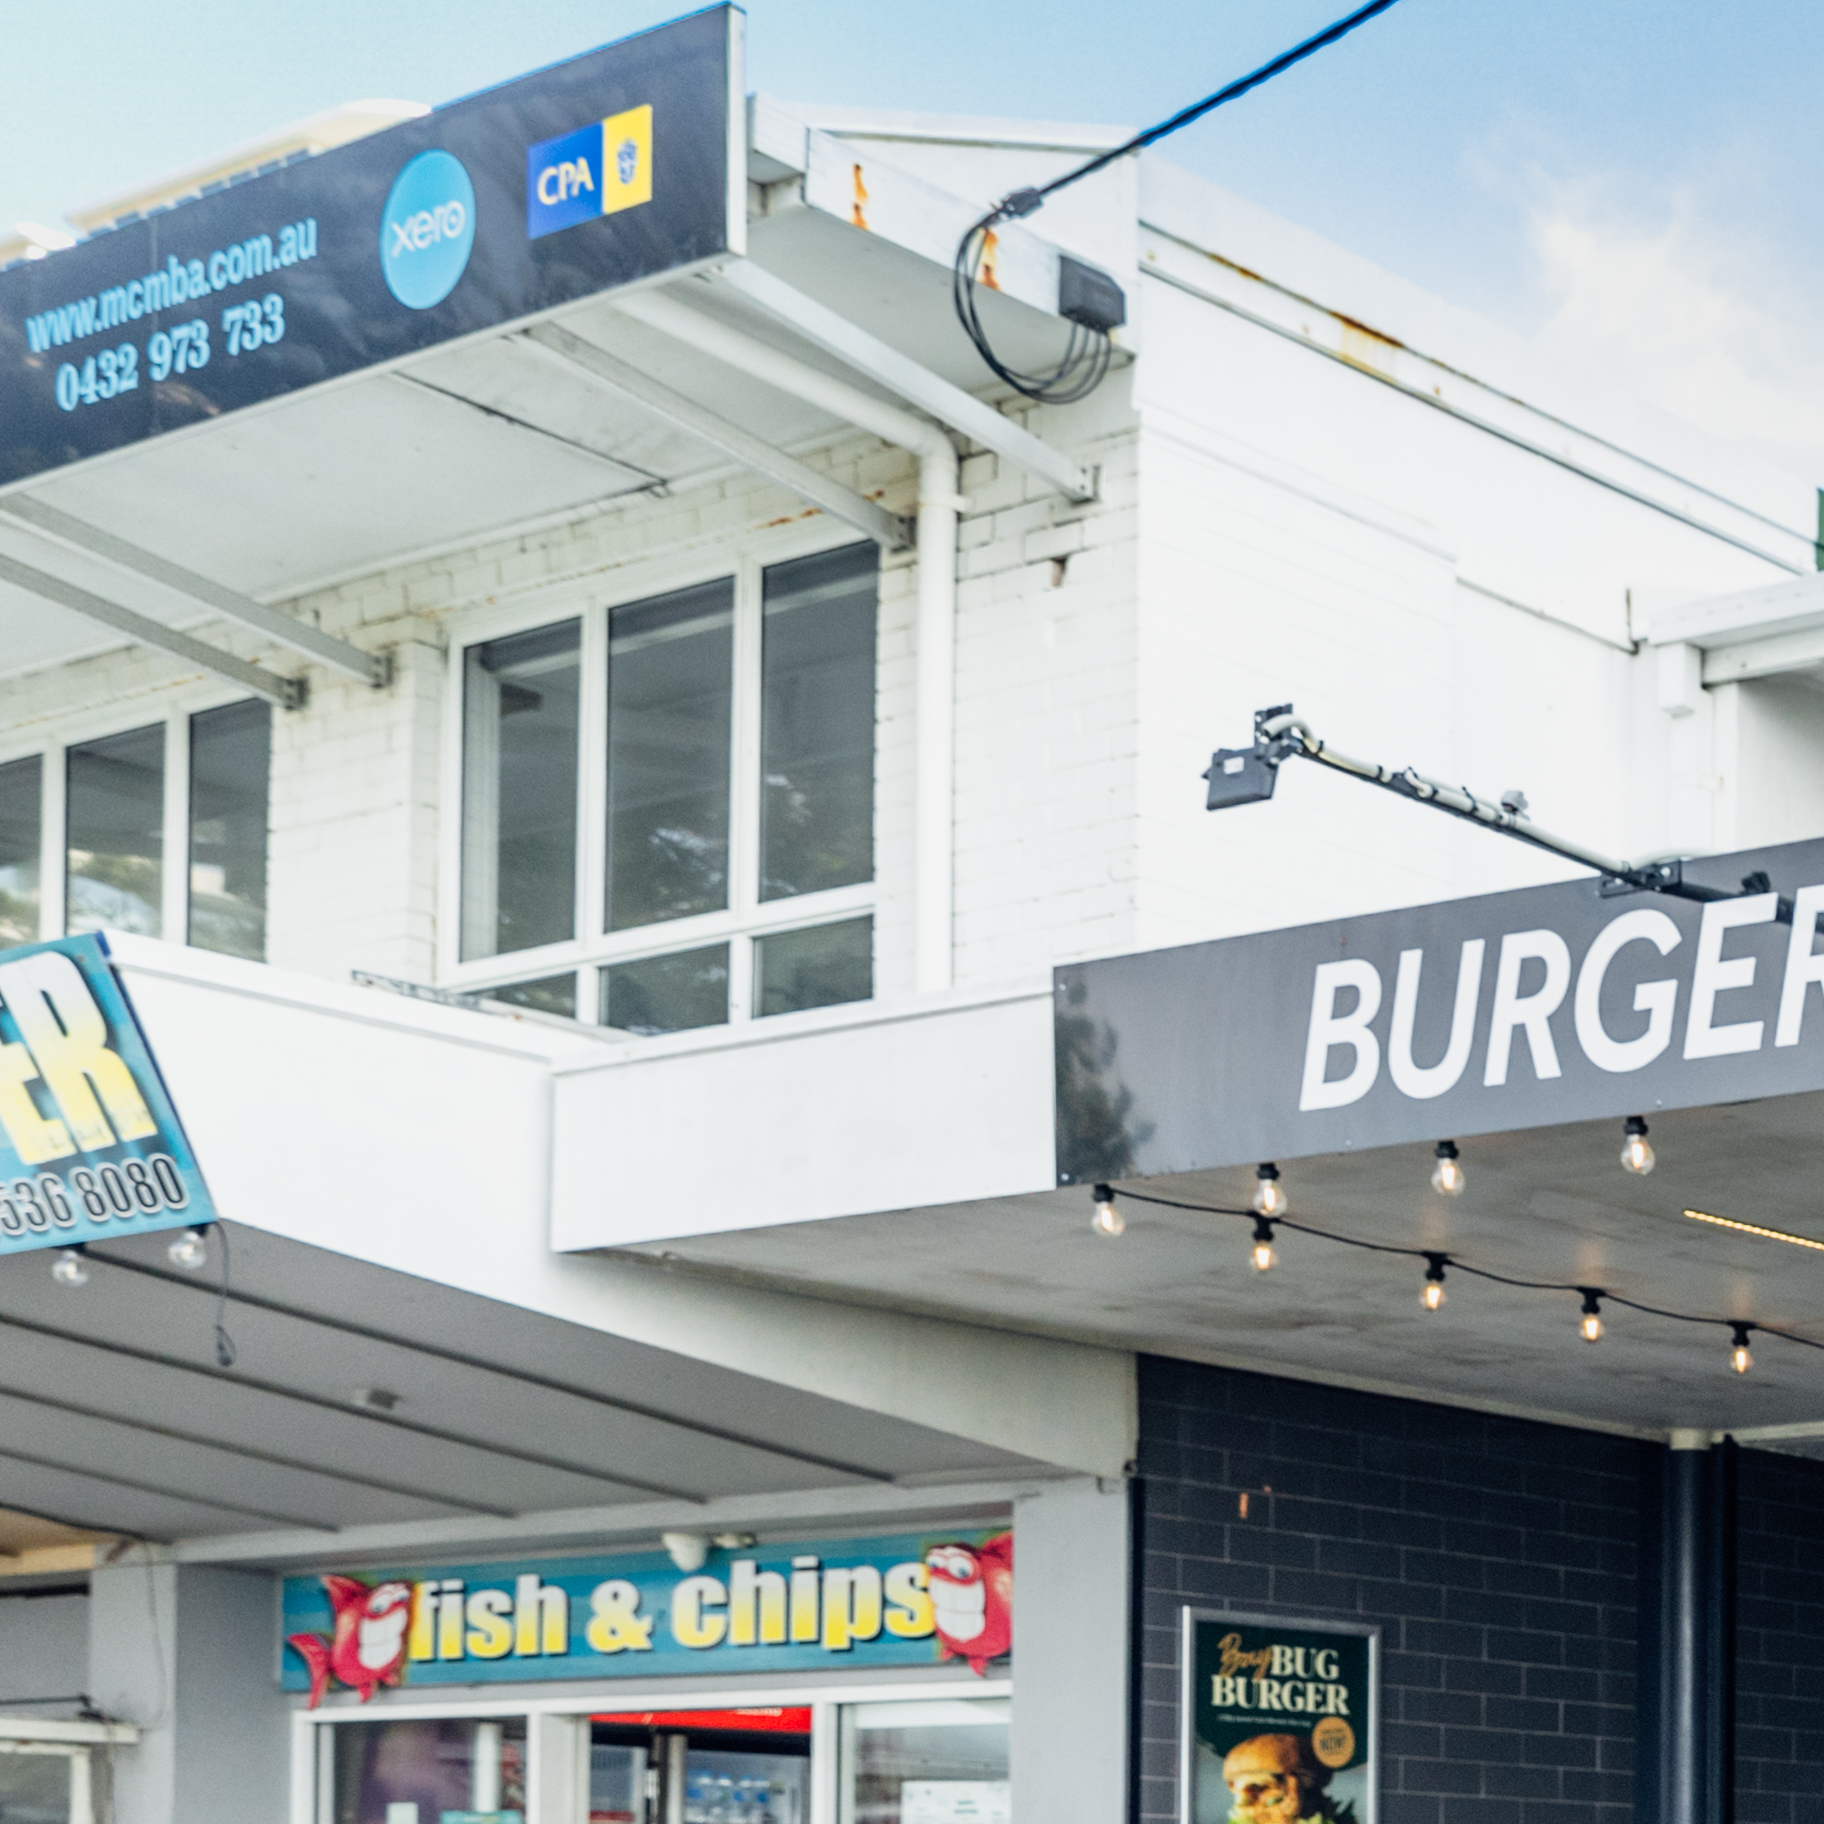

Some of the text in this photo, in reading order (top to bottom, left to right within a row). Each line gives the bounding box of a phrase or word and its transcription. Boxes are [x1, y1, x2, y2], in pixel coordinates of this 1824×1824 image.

[536, 156, 594, 206] CPA
[391, 200, 467, 257] xero
[26, 217, 319, 353] www.mcmba.com.au
[55, 294, 286, 412] 0432 973 733
[69, 1152, 190, 1223] 8080
[408, 1555, 938, 1663] fish & chips
[1211, 1674, 1350, 1715] BURGER
[1269, 1645, 1340, 1682] BUG
